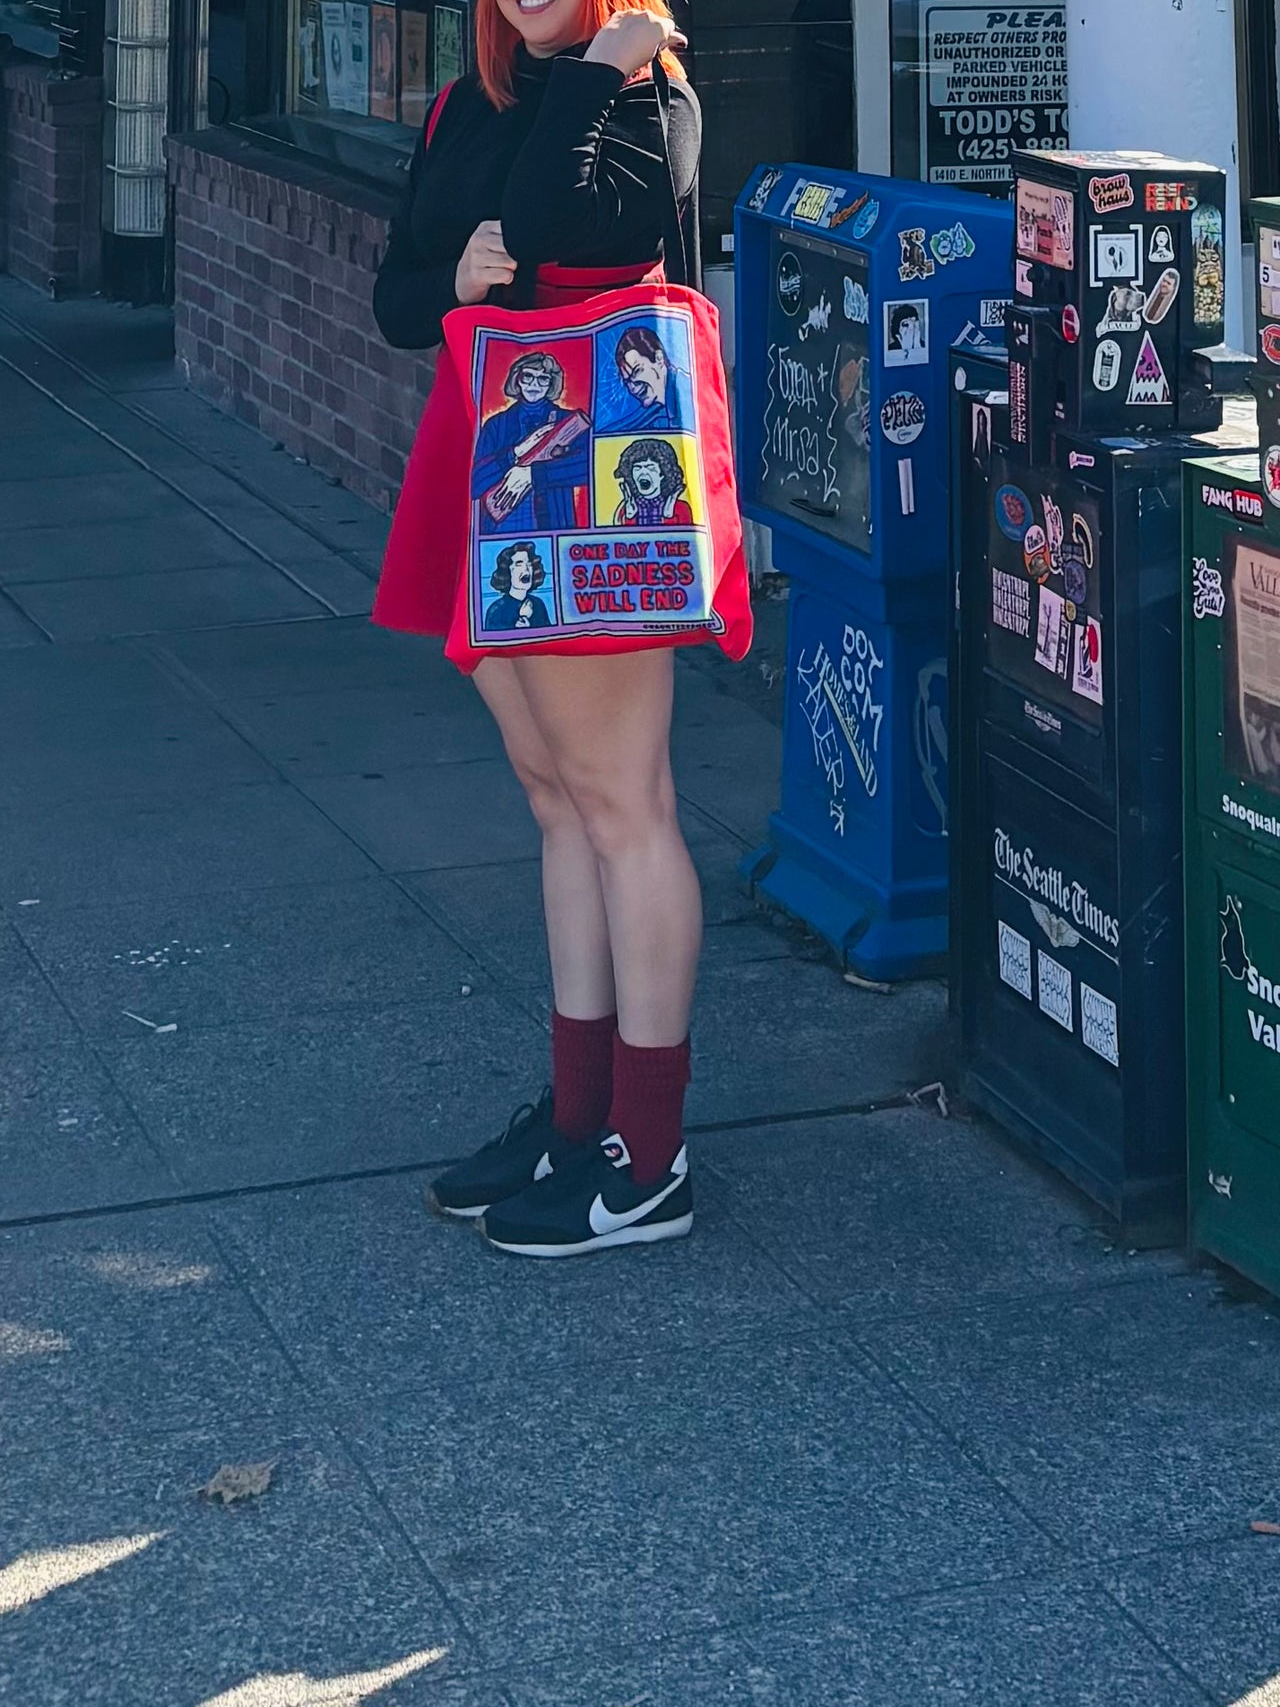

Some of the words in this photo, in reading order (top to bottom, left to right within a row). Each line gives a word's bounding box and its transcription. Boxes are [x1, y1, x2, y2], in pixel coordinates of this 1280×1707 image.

[986, 11, 1066, 29] PLEA
[933, 31, 987, 45] RESPECT
[990, 31, 1037, 45] OTHERS
[933, 45, 1041, 60] UNAUTHORIZED
[1045, 45, 1064, 59] OR
[953, 60, 1007, 74] PARKED
[1011, 59, 1067, 73] VEHICLE
[946, 74, 1028, 89] IMPOUNDED
[1031, 74, 1048, 87] 24
[946, 91, 965, 104] AT
[967, 89, 1026, 103] OWNERS
[1030, 88, 1063, 102] RISK
[939, 108, 1036, 136] TODD'S
[935, 168, 957, 181] 1410
[971, 167, 1006, 180] NORTH
[1202, 485, 1233, 514] FANG
[1234, 492, 1263, 518] HUB
[570, 543, 609, 561] ONE
[614, 541, 649, 559] DAY
[655, 540, 691, 557] THE
[572, 560, 695, 589] SADNESS
[574, 589, 637, 614] WILL
[640, 586, 688, 611] END
[994, 827, 1022, 880] The
[1022, 847, 1071, 913] Seattle
[1071, 880, 1119, 948] Times
